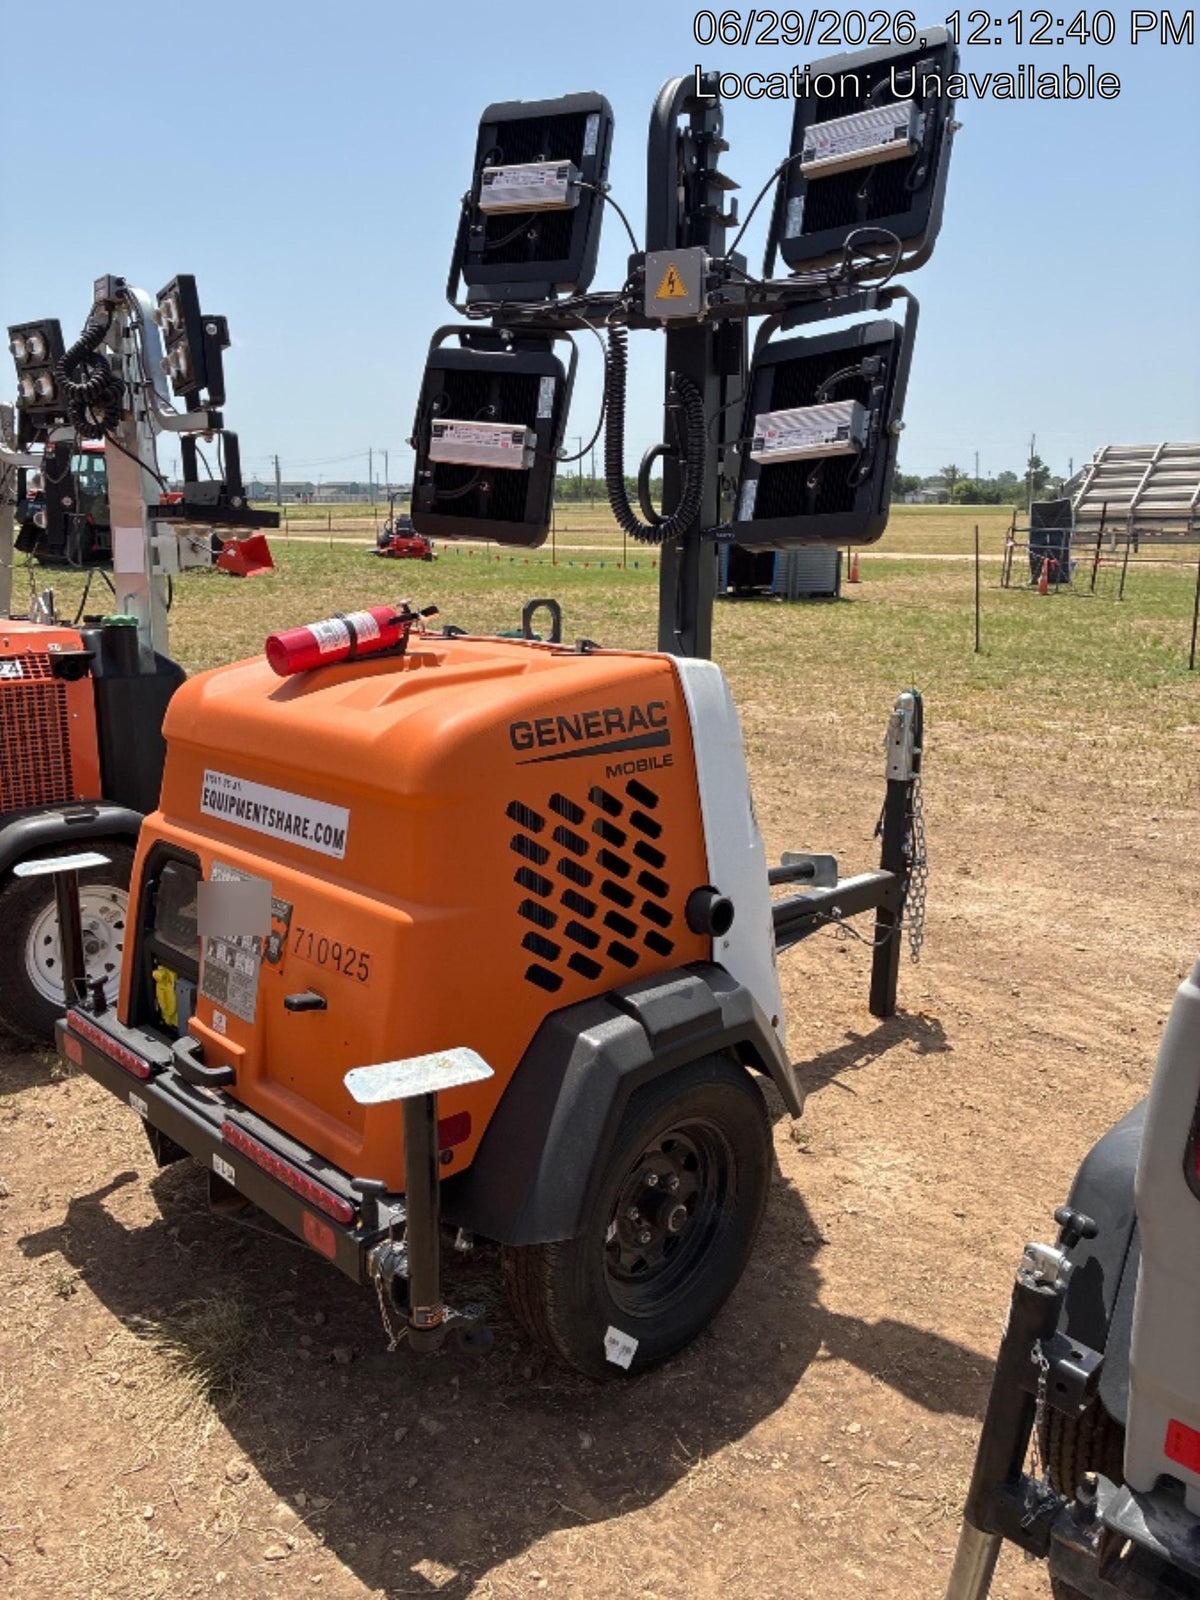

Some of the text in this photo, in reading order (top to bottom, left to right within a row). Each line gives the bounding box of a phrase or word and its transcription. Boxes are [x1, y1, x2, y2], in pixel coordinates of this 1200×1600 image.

[510, 701, 668, 751] GENERAC
[605, 753, 674, 779] MOBILE
[203, 787, 346, 850] EQUIPMENTSHARE.COM
[294, 927, 370, 982] 710925
